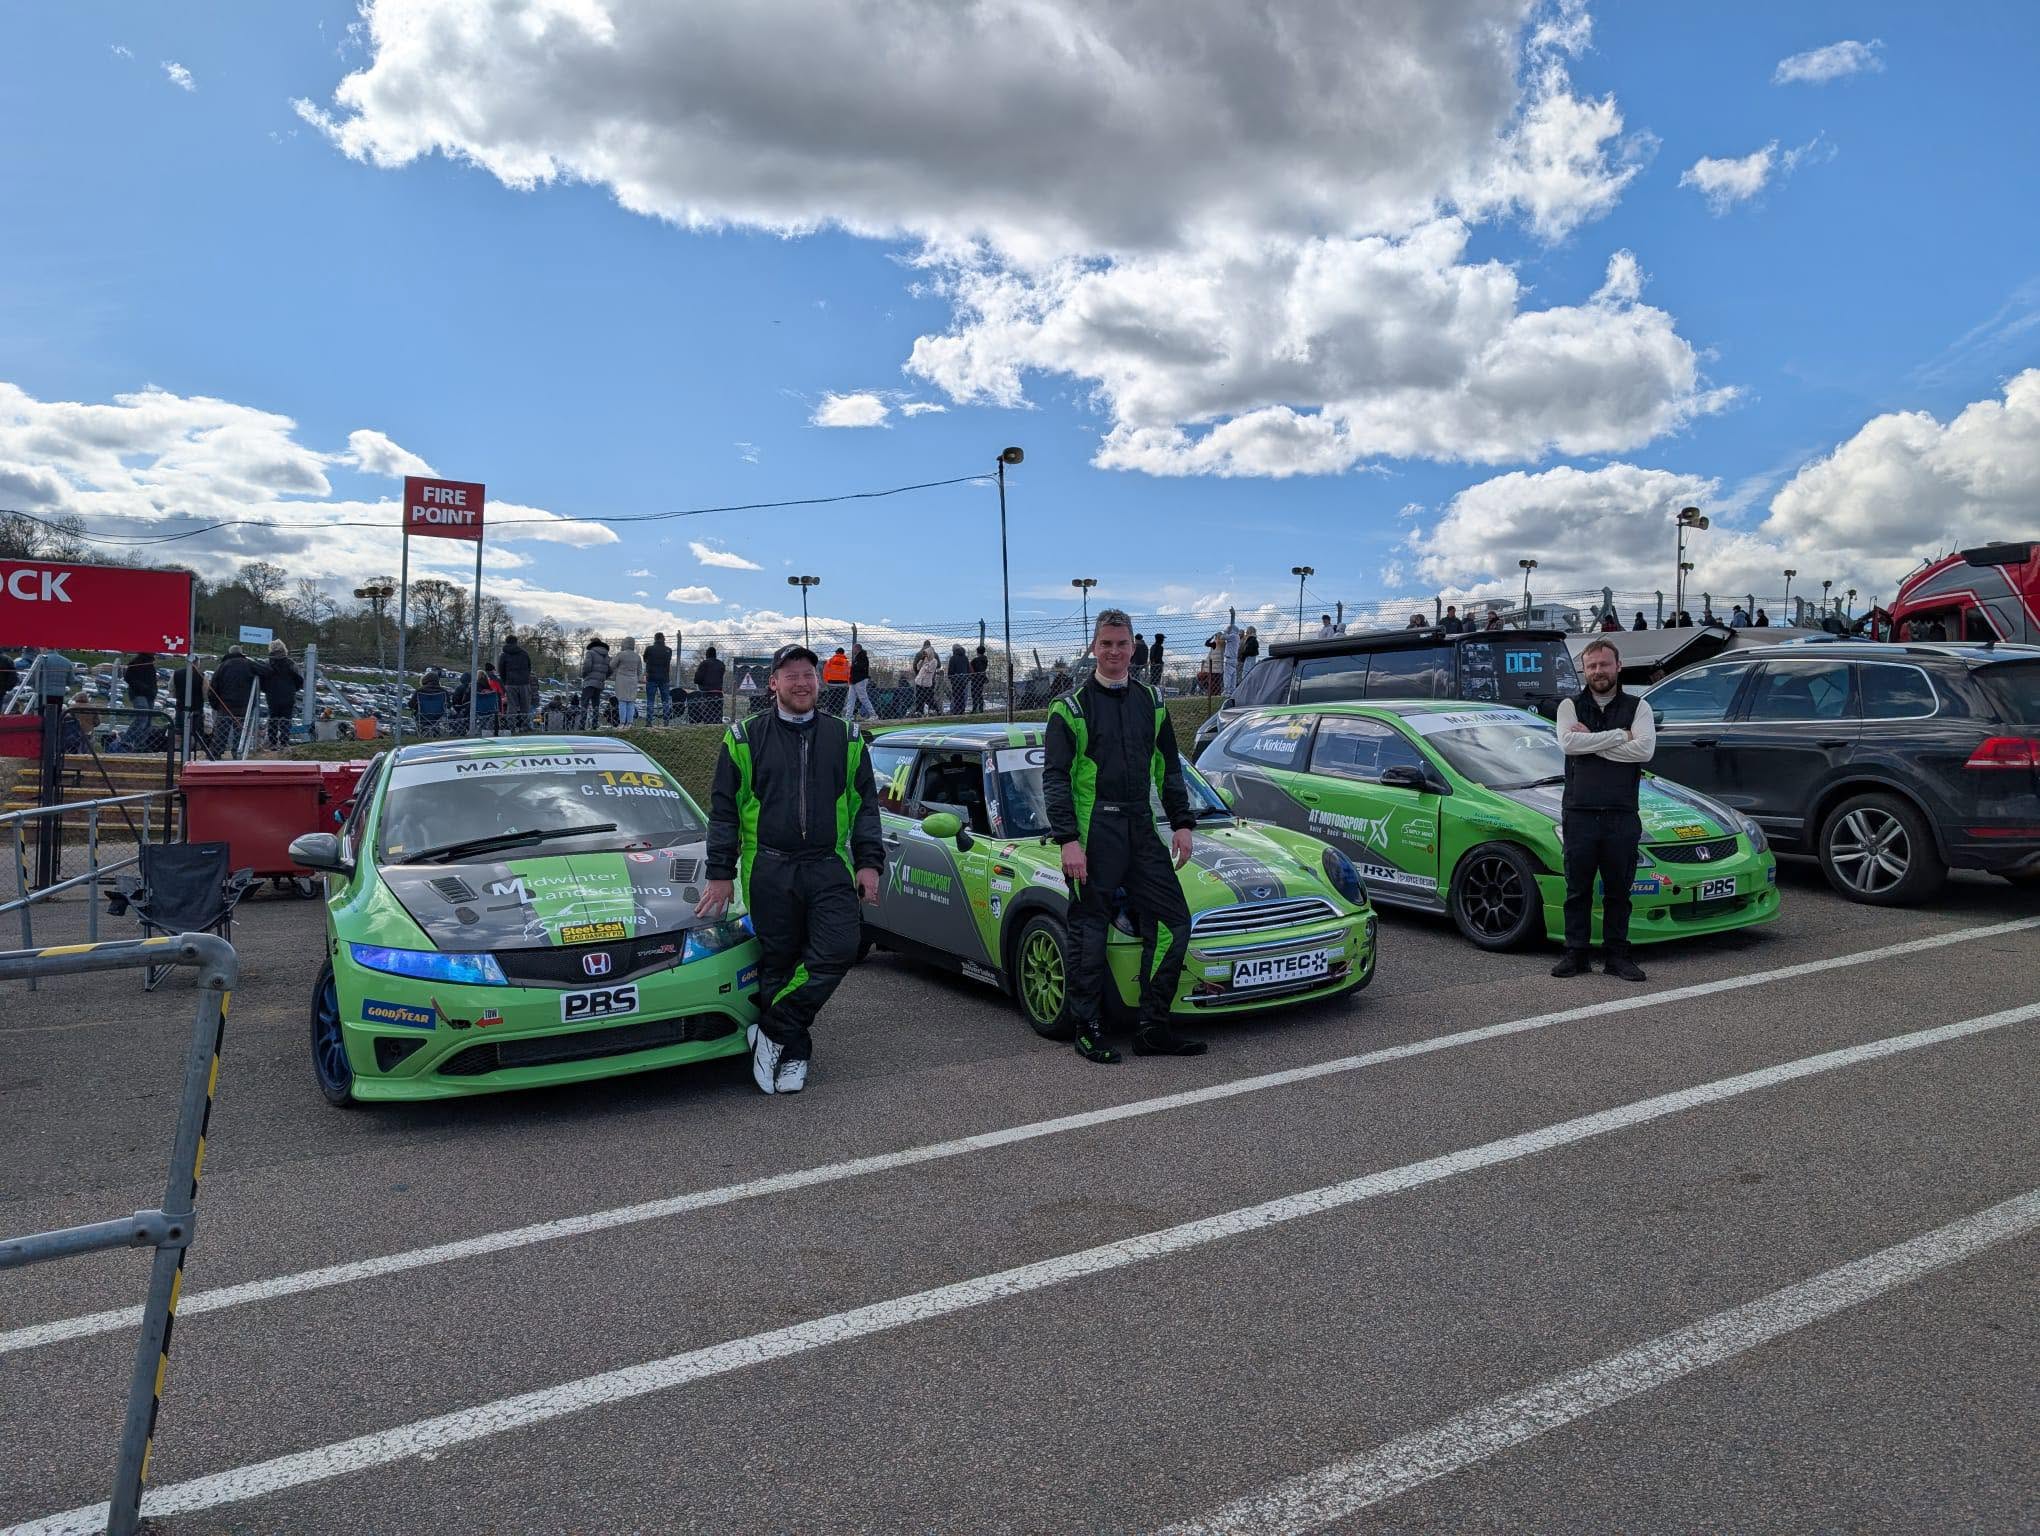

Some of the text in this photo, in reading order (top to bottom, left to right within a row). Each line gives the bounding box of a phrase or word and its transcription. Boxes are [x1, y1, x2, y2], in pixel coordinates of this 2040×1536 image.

[423, 486, 466, 506] FIRE
[412, 506, 475, 526] POINT
[0, 570, 72, 602] CK
[1443, 712, 1525, 725] MAXIMUM
[1263, 739, 1298, 753] Kirkland
[456, 757, 597, 773] MAXIMUM
[598, 771, 664, 788] 146
[581, 784, 681, 800] C. Eynstone
[1308, 808, 1369, 833] AT MOTORSPORT
[902, 864, 952, 894] AT MOTORSPORT
[1363, 864, 1396, 880] HRX
[492, 872, 619, 896] Midwinter
[515, 878, 672, 905] Landscaping
[1704, 878, 1735, 897] PBS
[562, 923, 624, 936] Steel Seal
[1236, 955, 1311, 978] AIRTEC
[1235, 969, 1311, 985] MOTORSPORT
[368, 1006, 429, 1024] GOODYEAR
